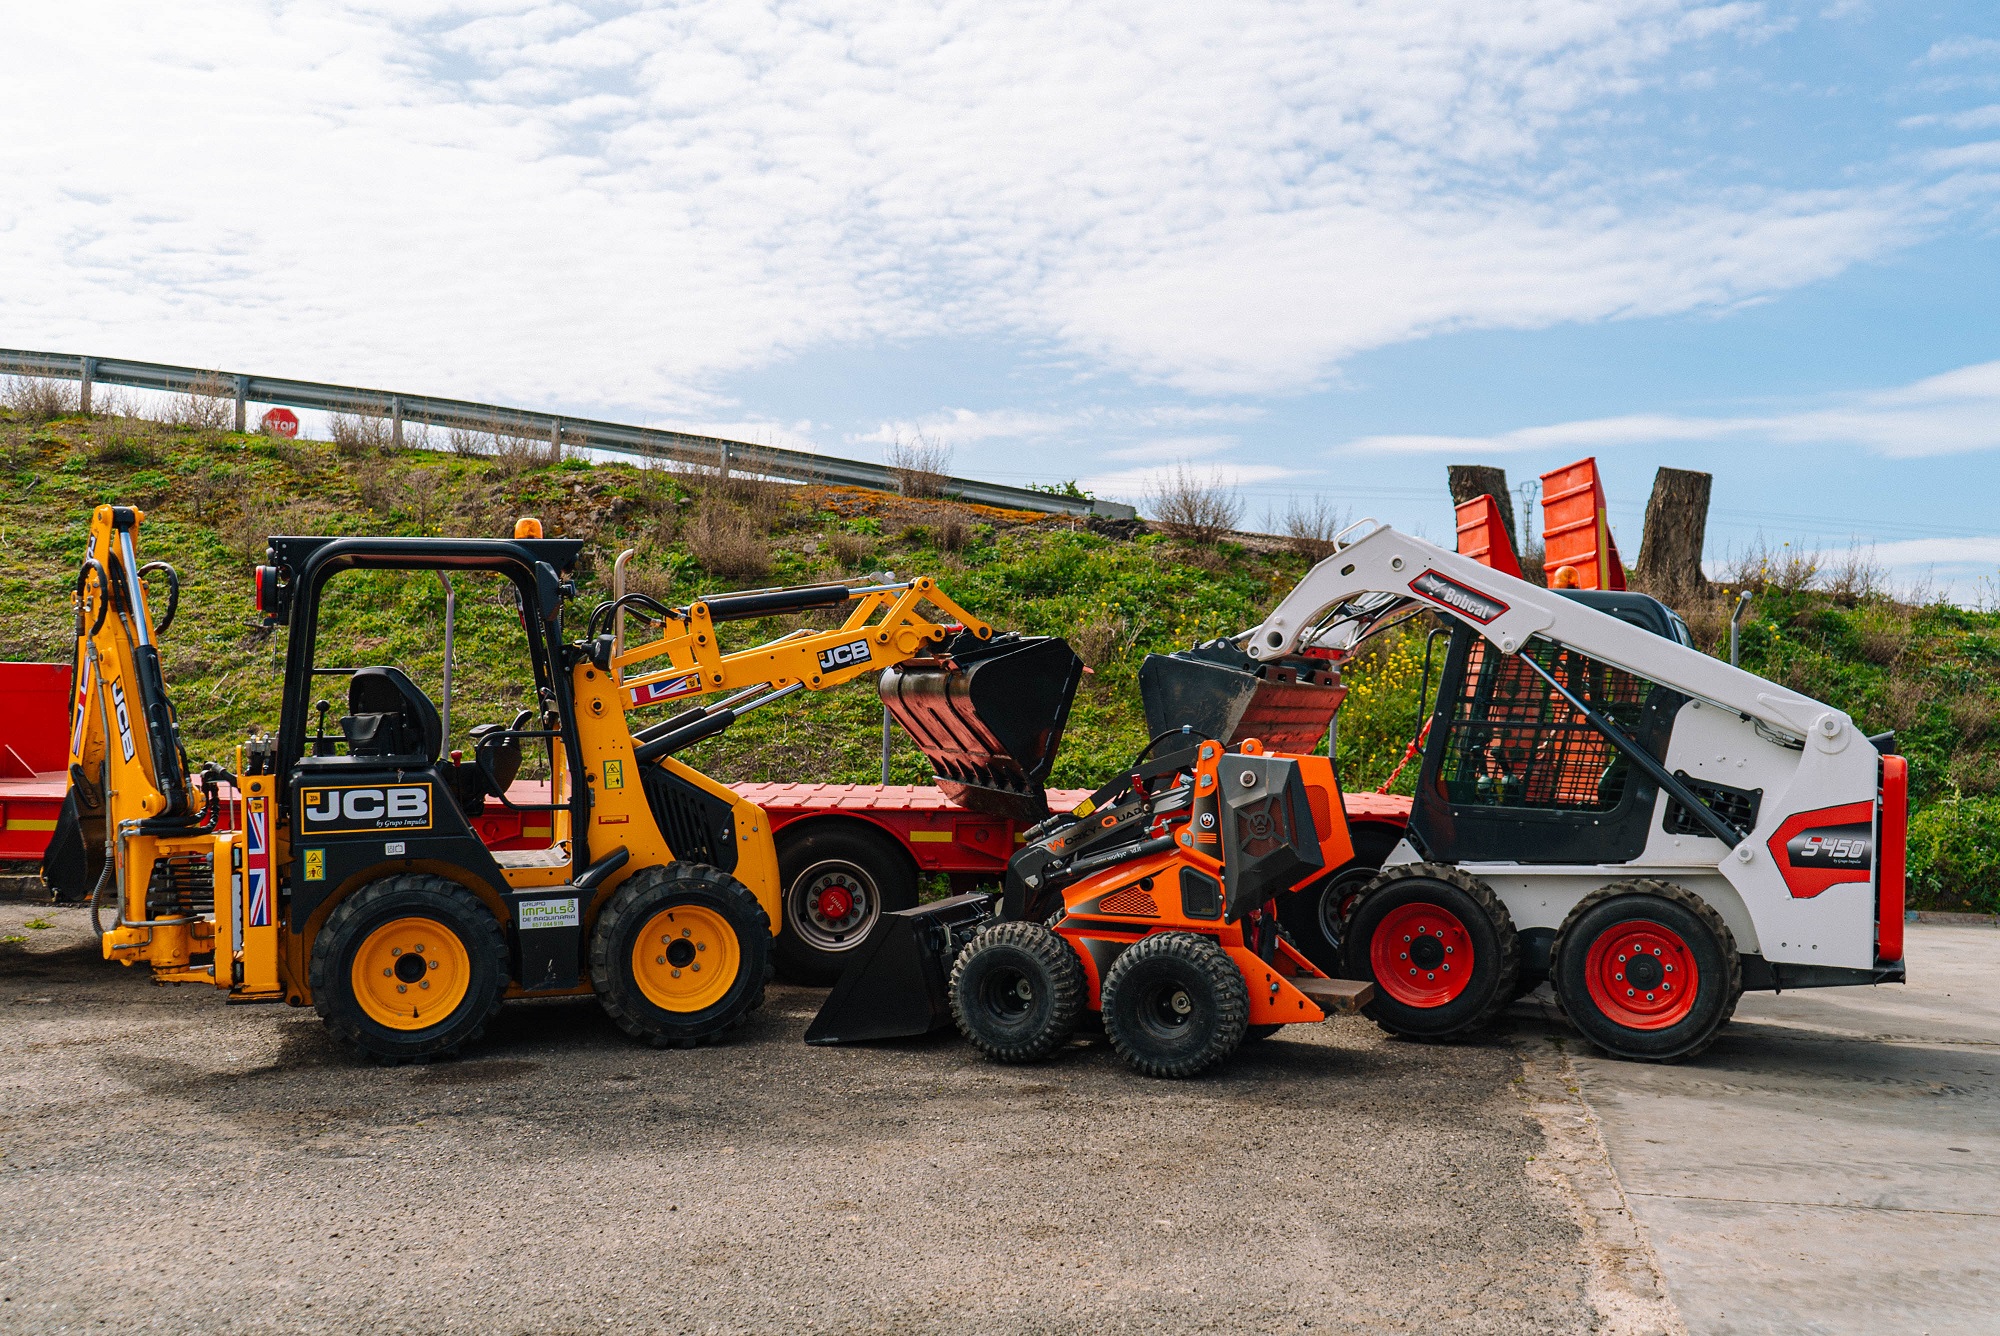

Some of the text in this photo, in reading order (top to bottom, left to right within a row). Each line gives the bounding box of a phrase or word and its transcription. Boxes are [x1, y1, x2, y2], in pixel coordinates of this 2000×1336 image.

[265, 420, 296, 431] STOP
[1443, 587, 1490, 619] Bobcat
[820, 640, 870, 669] JCB
[112, 682, 135, 762] JCB
[306, 787, 429, 822] JCB
[377, 820, 383, 828] by
[403, 818, 427, 826] Impulso
[1801, 836, 1866, 858] S450
[522, 904, 576, 916] IMPULSO
